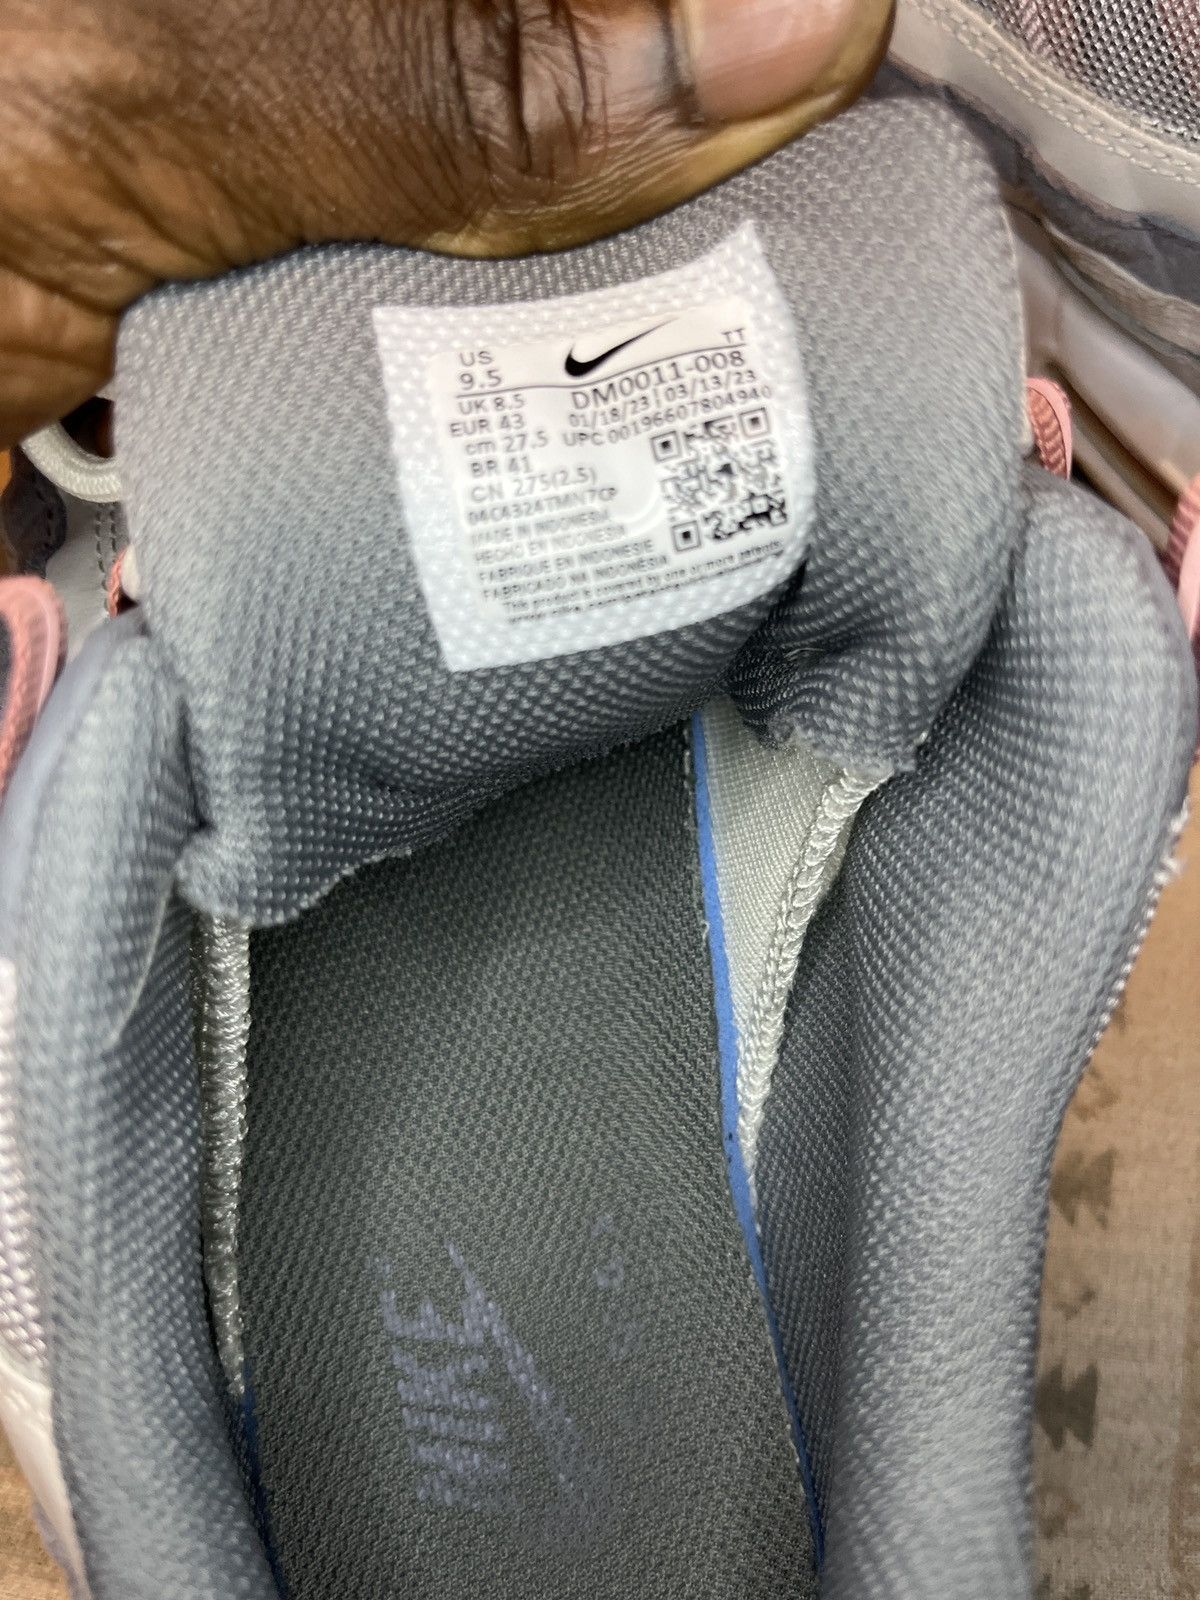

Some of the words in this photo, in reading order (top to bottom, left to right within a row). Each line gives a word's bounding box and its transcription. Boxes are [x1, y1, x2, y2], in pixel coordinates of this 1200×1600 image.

[721, 327, 746, 343] TT
[459, 350, 493, 367] US
[459, 370, 502, 390] 9.5
[570, 350, 745, 410] DM0011-008
[458, 400, 488, 415] UK
[494, 393, 525, 411] 8.5
[450, 418, 490, 436] EUR
[500, 412, 525, 430] 43
[465, 440, 496, 455] cm
[503, 430, 549, 453] 27.5
[561, 431, 605, 448] UPC
[471, 459, 499, 478] BR
[508, 456, 532, 474] 41
[471, 482, 504, 502] CN
